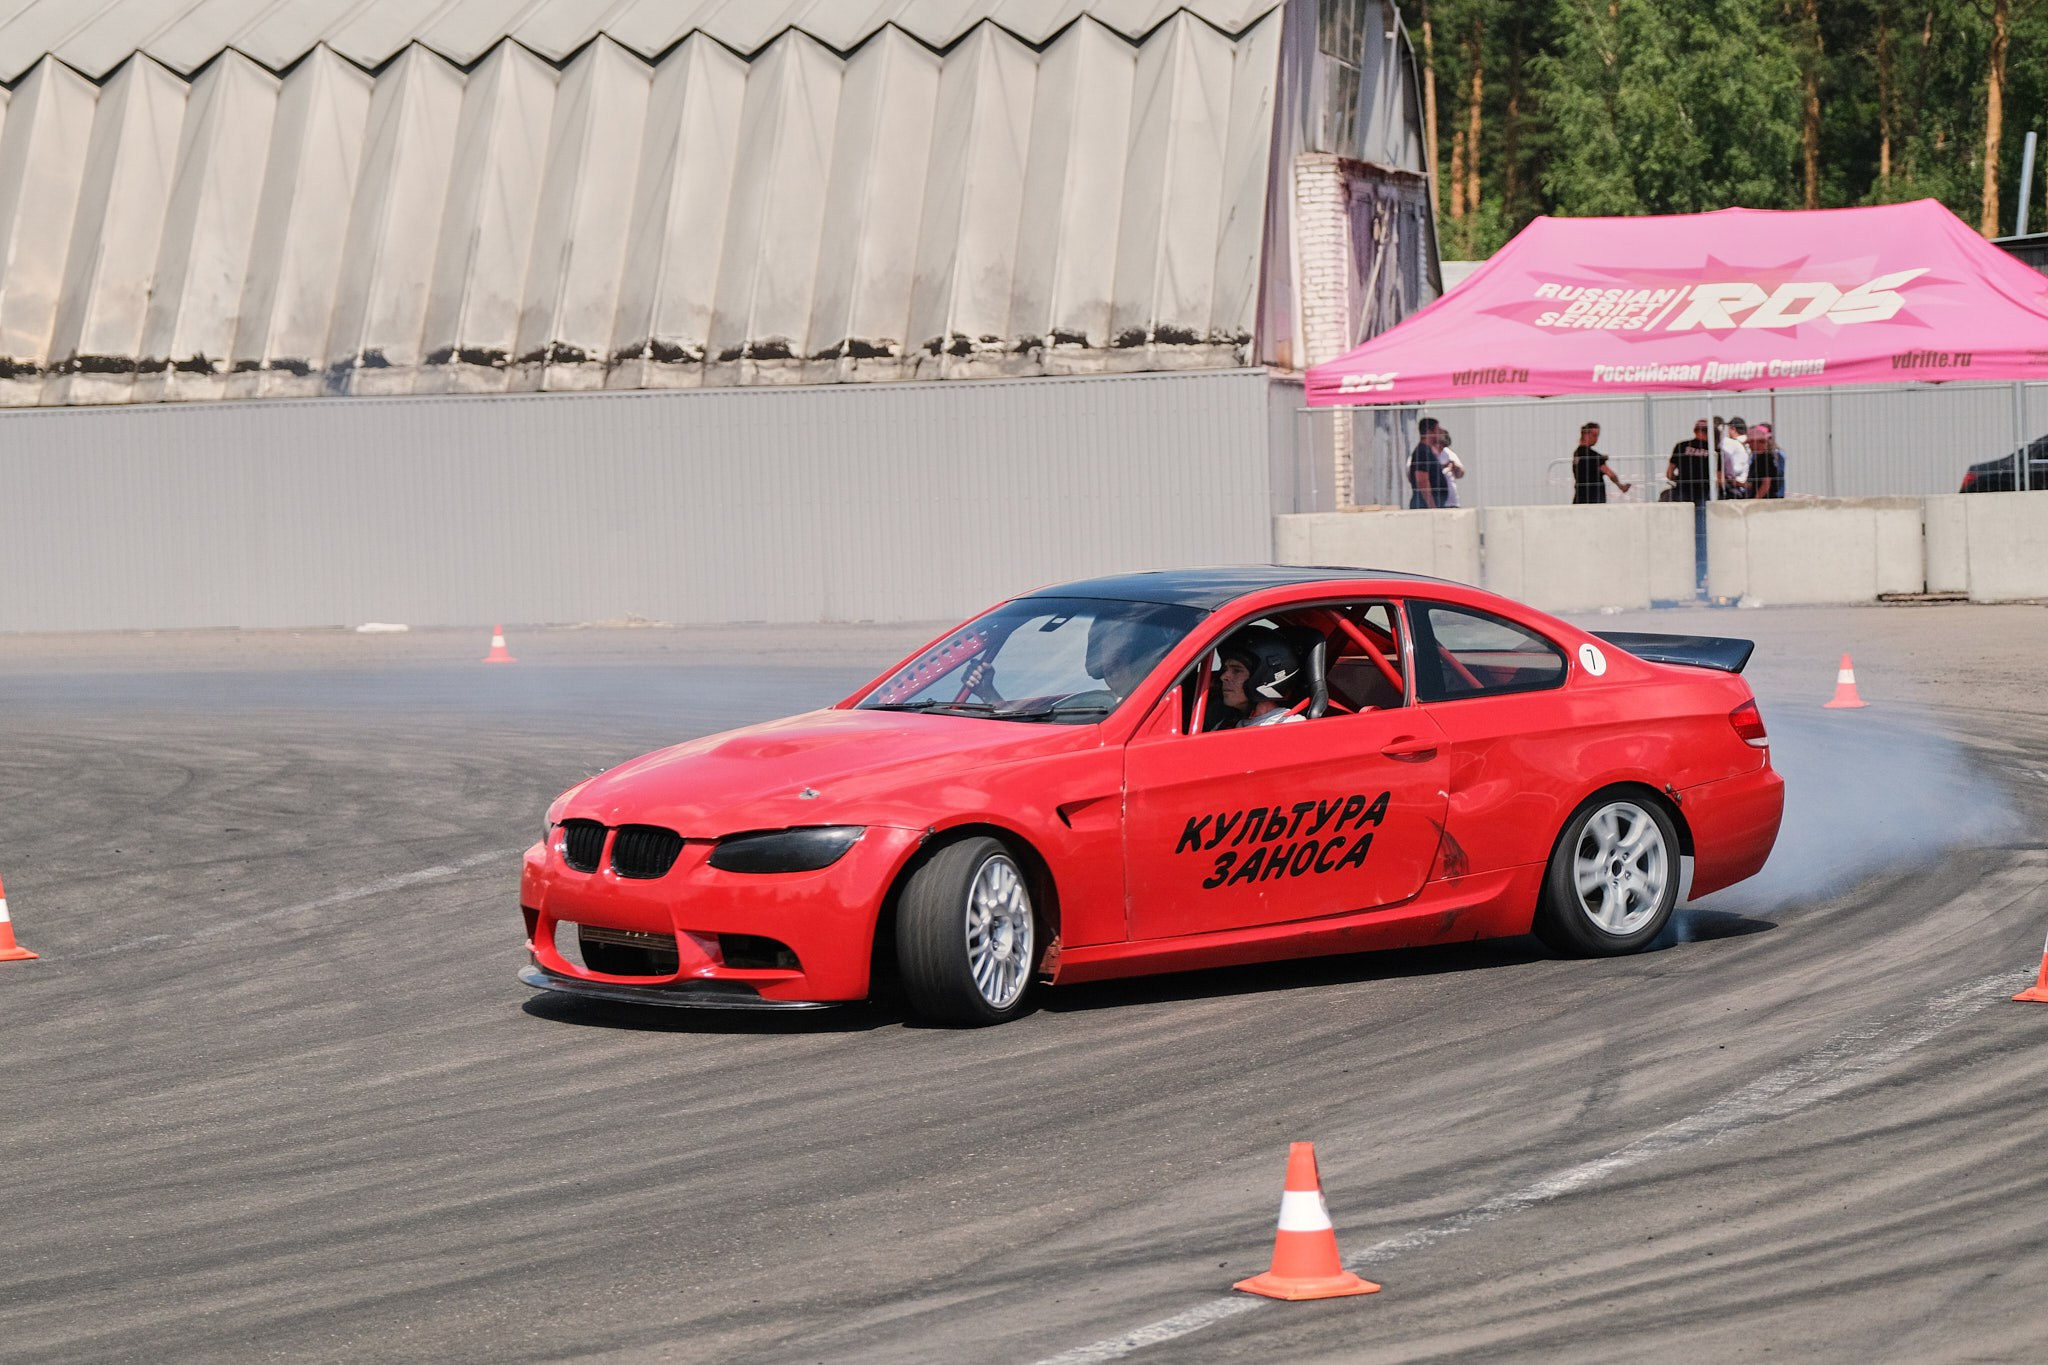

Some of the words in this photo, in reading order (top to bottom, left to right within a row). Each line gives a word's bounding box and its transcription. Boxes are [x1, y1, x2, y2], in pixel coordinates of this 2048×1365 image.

[1534, 283, 1676, 304] RUSSIAN
[1666, 267, 1931, 331] RDS
[1564, 301, 1664, 317] DRIFT
[1534, 312, 1648, 330] SERIES
[1892, 350, 1972, 370] vdrifte.ru
[1338, 371, 1399, 394] RDS
[1452, 368, 1529, 386] vdrifte.ru
[1592, 362, 1701, 383] Российская
[1702, 361, 1767, 384] Дрифт
[1768, 359, 1826, 378] Серия
[1175, 791, 1391, 854] КУЛЬТУРА
[1202, 832, 1374, 889] ЗАНОСА
